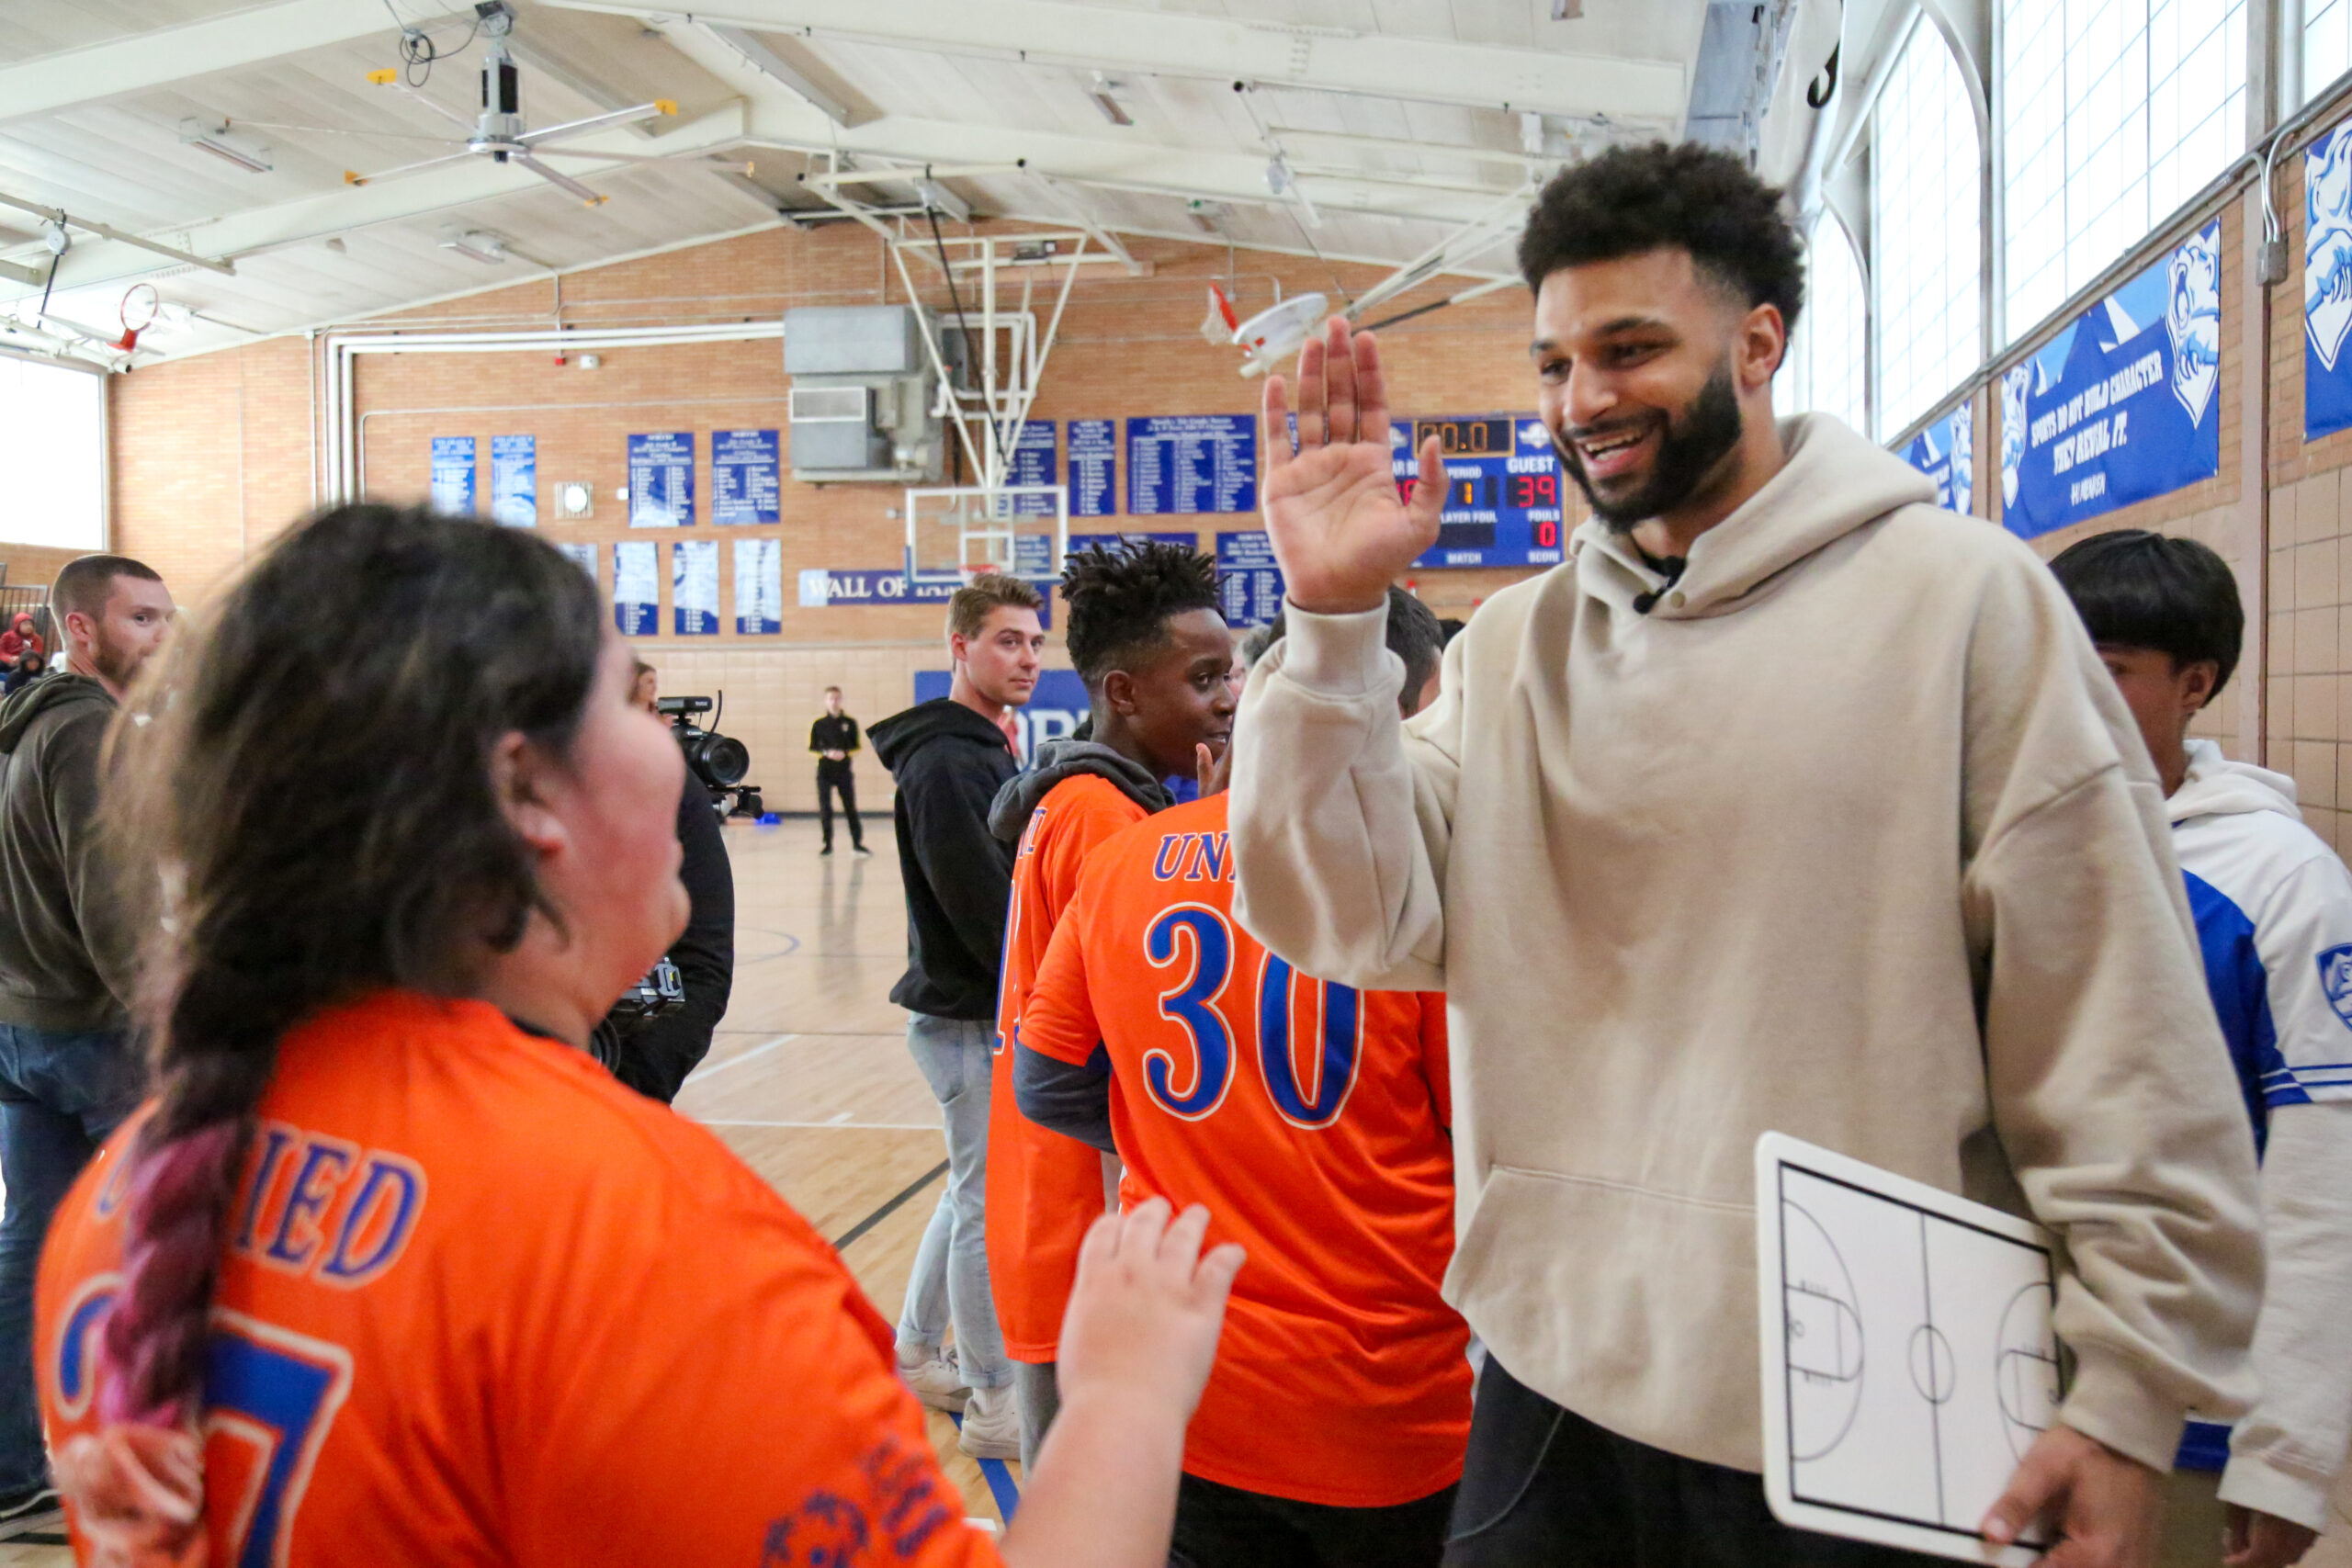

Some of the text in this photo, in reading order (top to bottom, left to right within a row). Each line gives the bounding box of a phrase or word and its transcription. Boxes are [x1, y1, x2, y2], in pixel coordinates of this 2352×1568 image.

[2110, 349, 2163, 406] CHARACTER
[1507, 456, 1555, 473] GUEST
[1518, 476, 1556, 508] 39
[1440, 510, 1498, 525] LAYER FOUL
[1527, 509, 1560, 522] FOULS
[1539, 521, 1556, 547] 0
[1447, 552, 1482, 564] MATCH
[808, 577, 873, 598] WALL
[1153, 830, 1236, 883] UN
[1143, 901, 1365, 1130] 30
